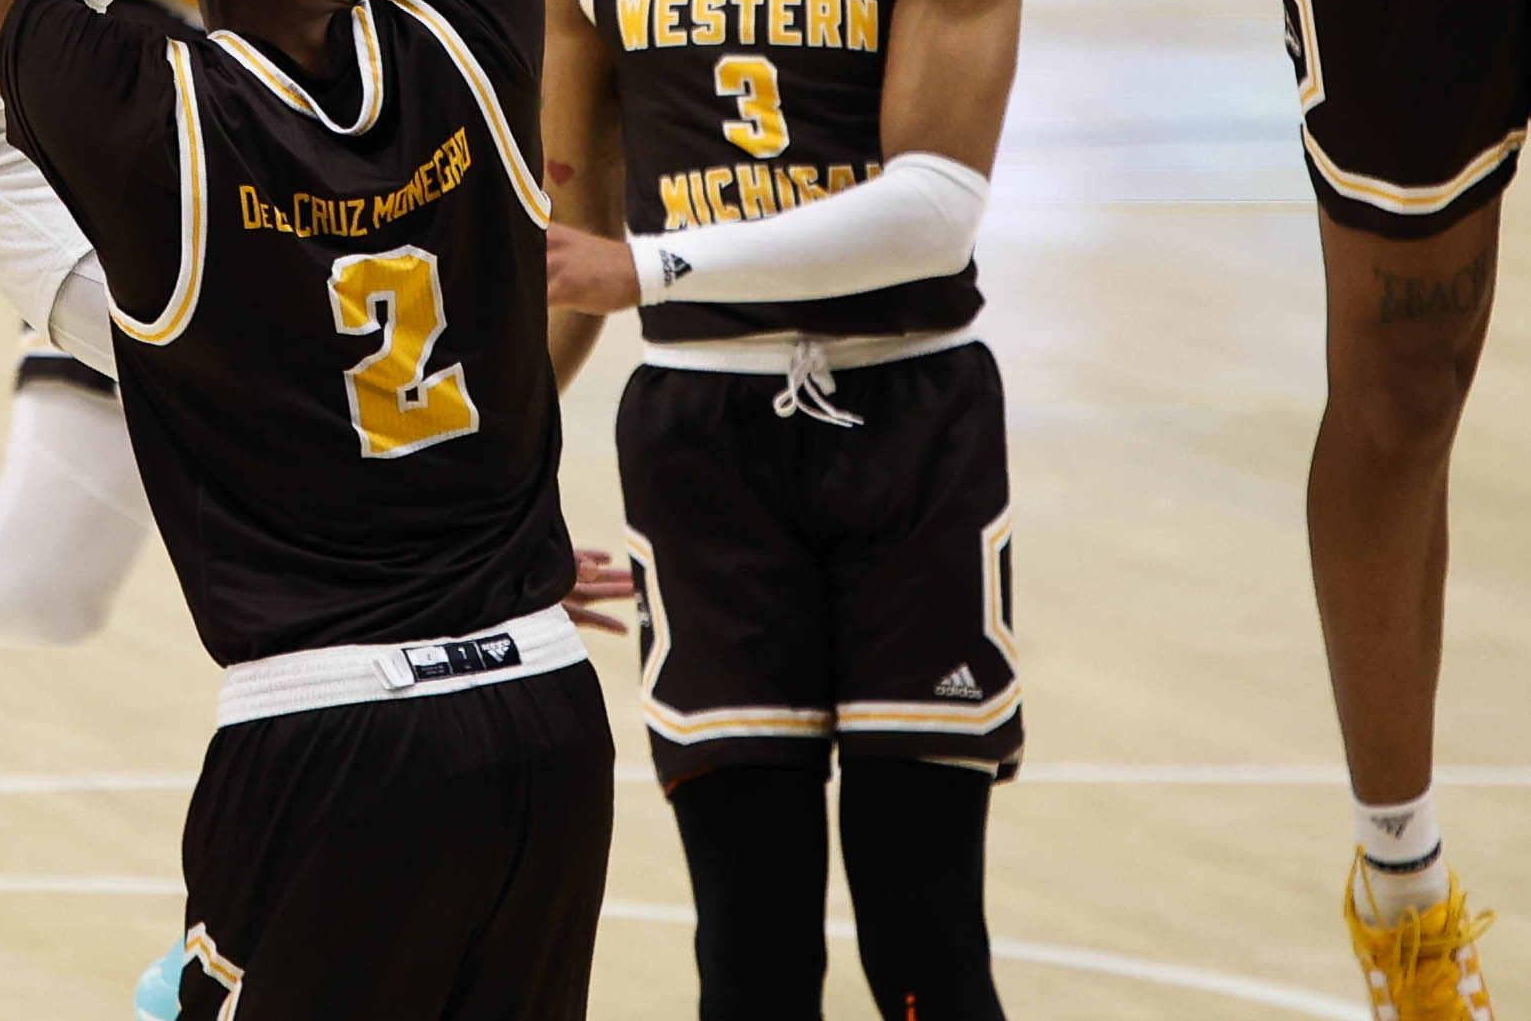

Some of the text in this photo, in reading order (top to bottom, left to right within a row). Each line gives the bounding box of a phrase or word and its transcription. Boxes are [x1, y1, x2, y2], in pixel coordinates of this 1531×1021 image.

[714, 54, 790, 159] 3
[293, 192, 368, 238] CRUZ
[372, 126, 471, 229] MONEGRO
[660, 162, 883, 230] MICHIGA
[327, 245, 479, 459] 2
